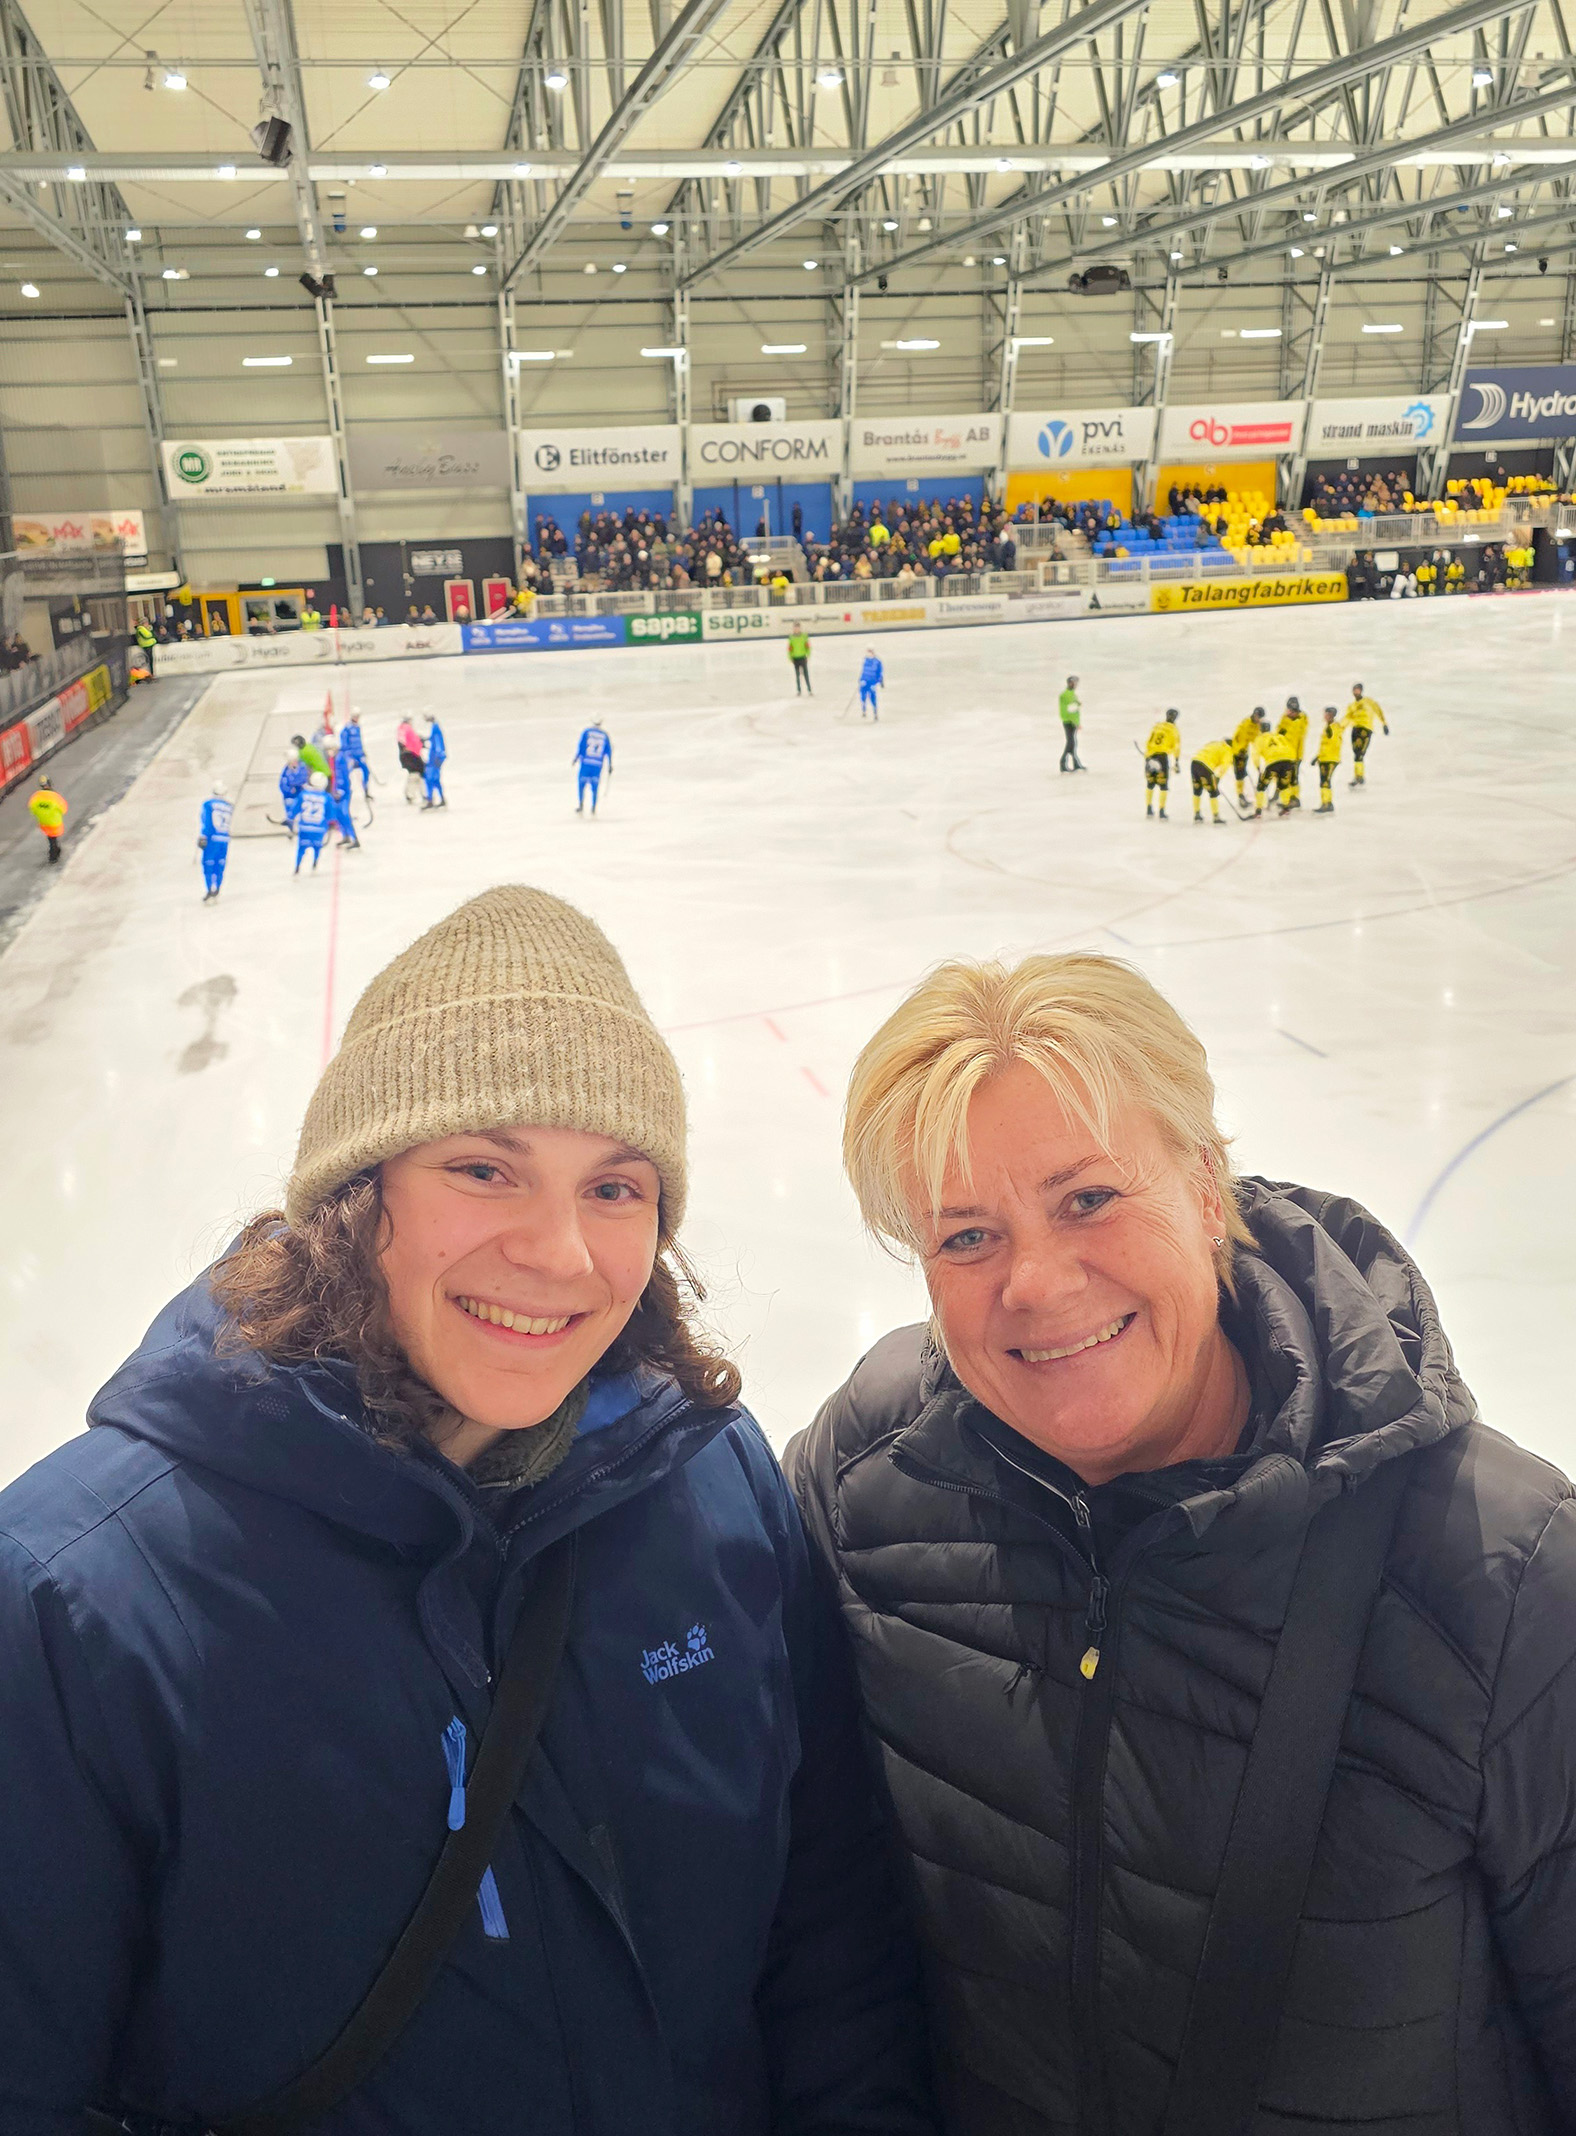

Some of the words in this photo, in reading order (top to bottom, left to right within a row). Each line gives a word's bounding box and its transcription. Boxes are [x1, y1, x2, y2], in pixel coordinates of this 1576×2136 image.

[1509, 390, 1576, 424] Hydro
[966, 427, 990, 442] AB
[1082, 414, 1123, 444] pvi
[1189, 416, 1229, 446] ab
[1322, 422, 1364, 439] strand
[1366, 420, 1413, 437] maskin
[569, 447, 668, 466] Elitfönster
[700, 437, 829, 463] CONFORM
[53, 519, 84, 539] MAX
[1181, 579, 1343, 604] Talangfabriken
[631, 615, 698, 641] sapa:
[708, 613, 770, 633] sapa:
[640, 1640, 680, 1669] Jack
[642, 1647, 715, 1685] Wolfskin
